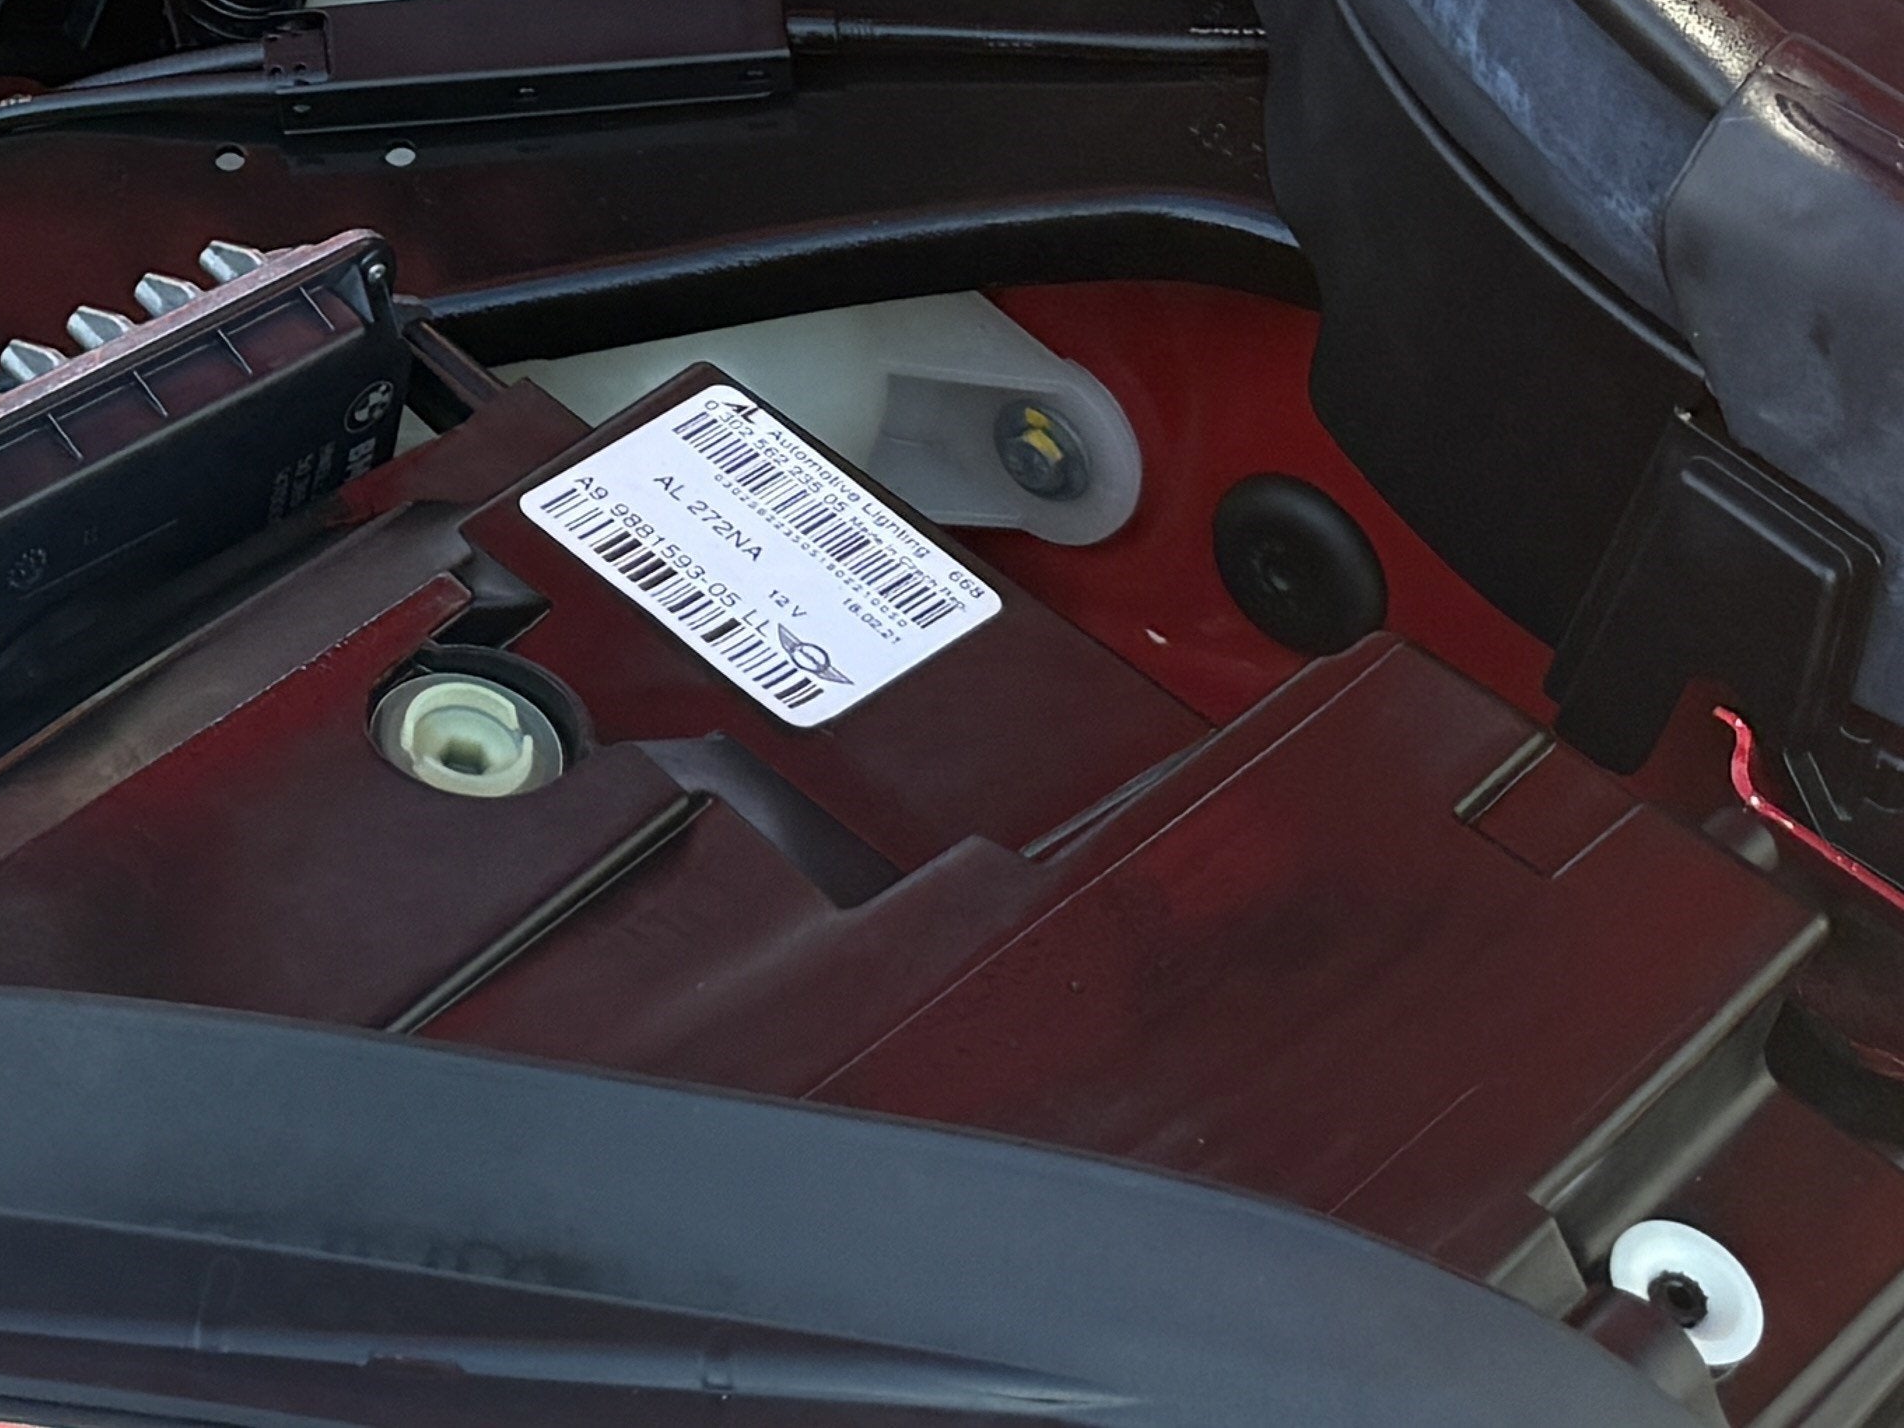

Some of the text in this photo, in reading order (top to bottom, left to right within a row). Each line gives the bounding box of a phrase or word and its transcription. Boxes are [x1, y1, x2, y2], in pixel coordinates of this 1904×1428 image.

[704, 399, 850, 513] 0 302 562 235 05
[574, 475, 770, 638] A9 9881593-05 LL
[654, 475, 762, 562] AL 272NA
[767, 430, 861, 503] Automotive
[861, 501, 931, 559] Lighting
[948, 570, 985, 598] 668
[768, 589, 808, 618] 12 V
